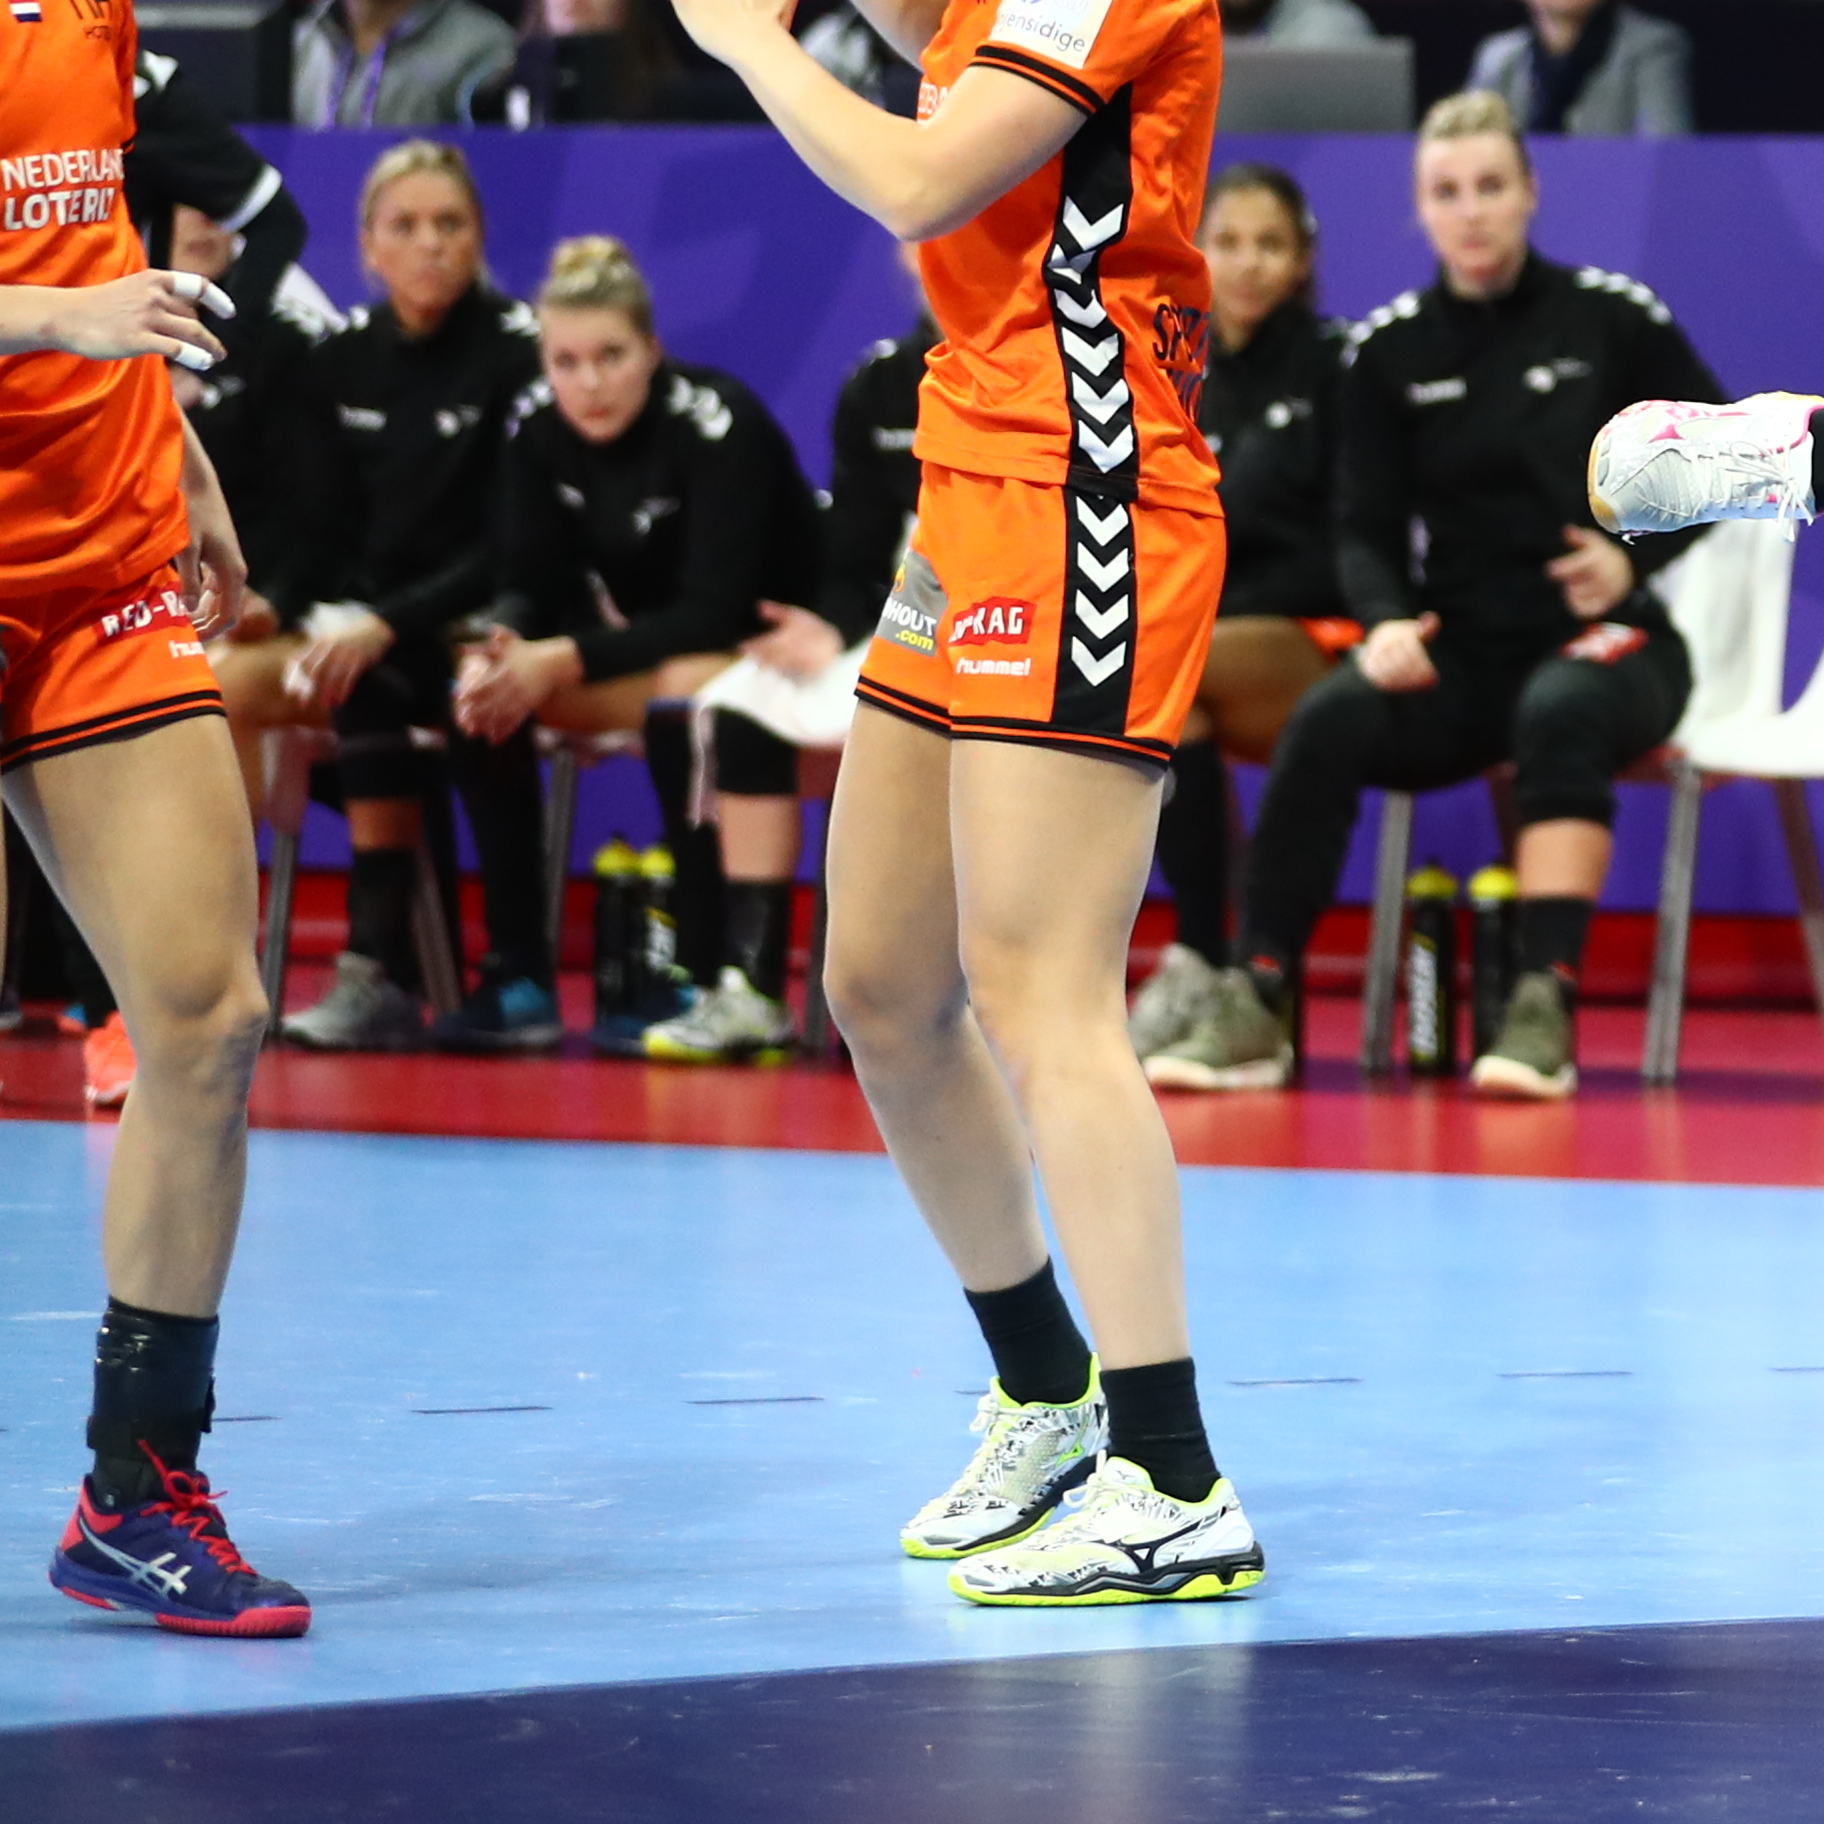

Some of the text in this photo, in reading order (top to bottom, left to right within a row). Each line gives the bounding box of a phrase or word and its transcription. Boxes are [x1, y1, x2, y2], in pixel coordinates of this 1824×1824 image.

[997, 12, 1086, 52] jensidige
[895, 628, 935, 652] .com
[956, 656, 1032, 676] hummel
